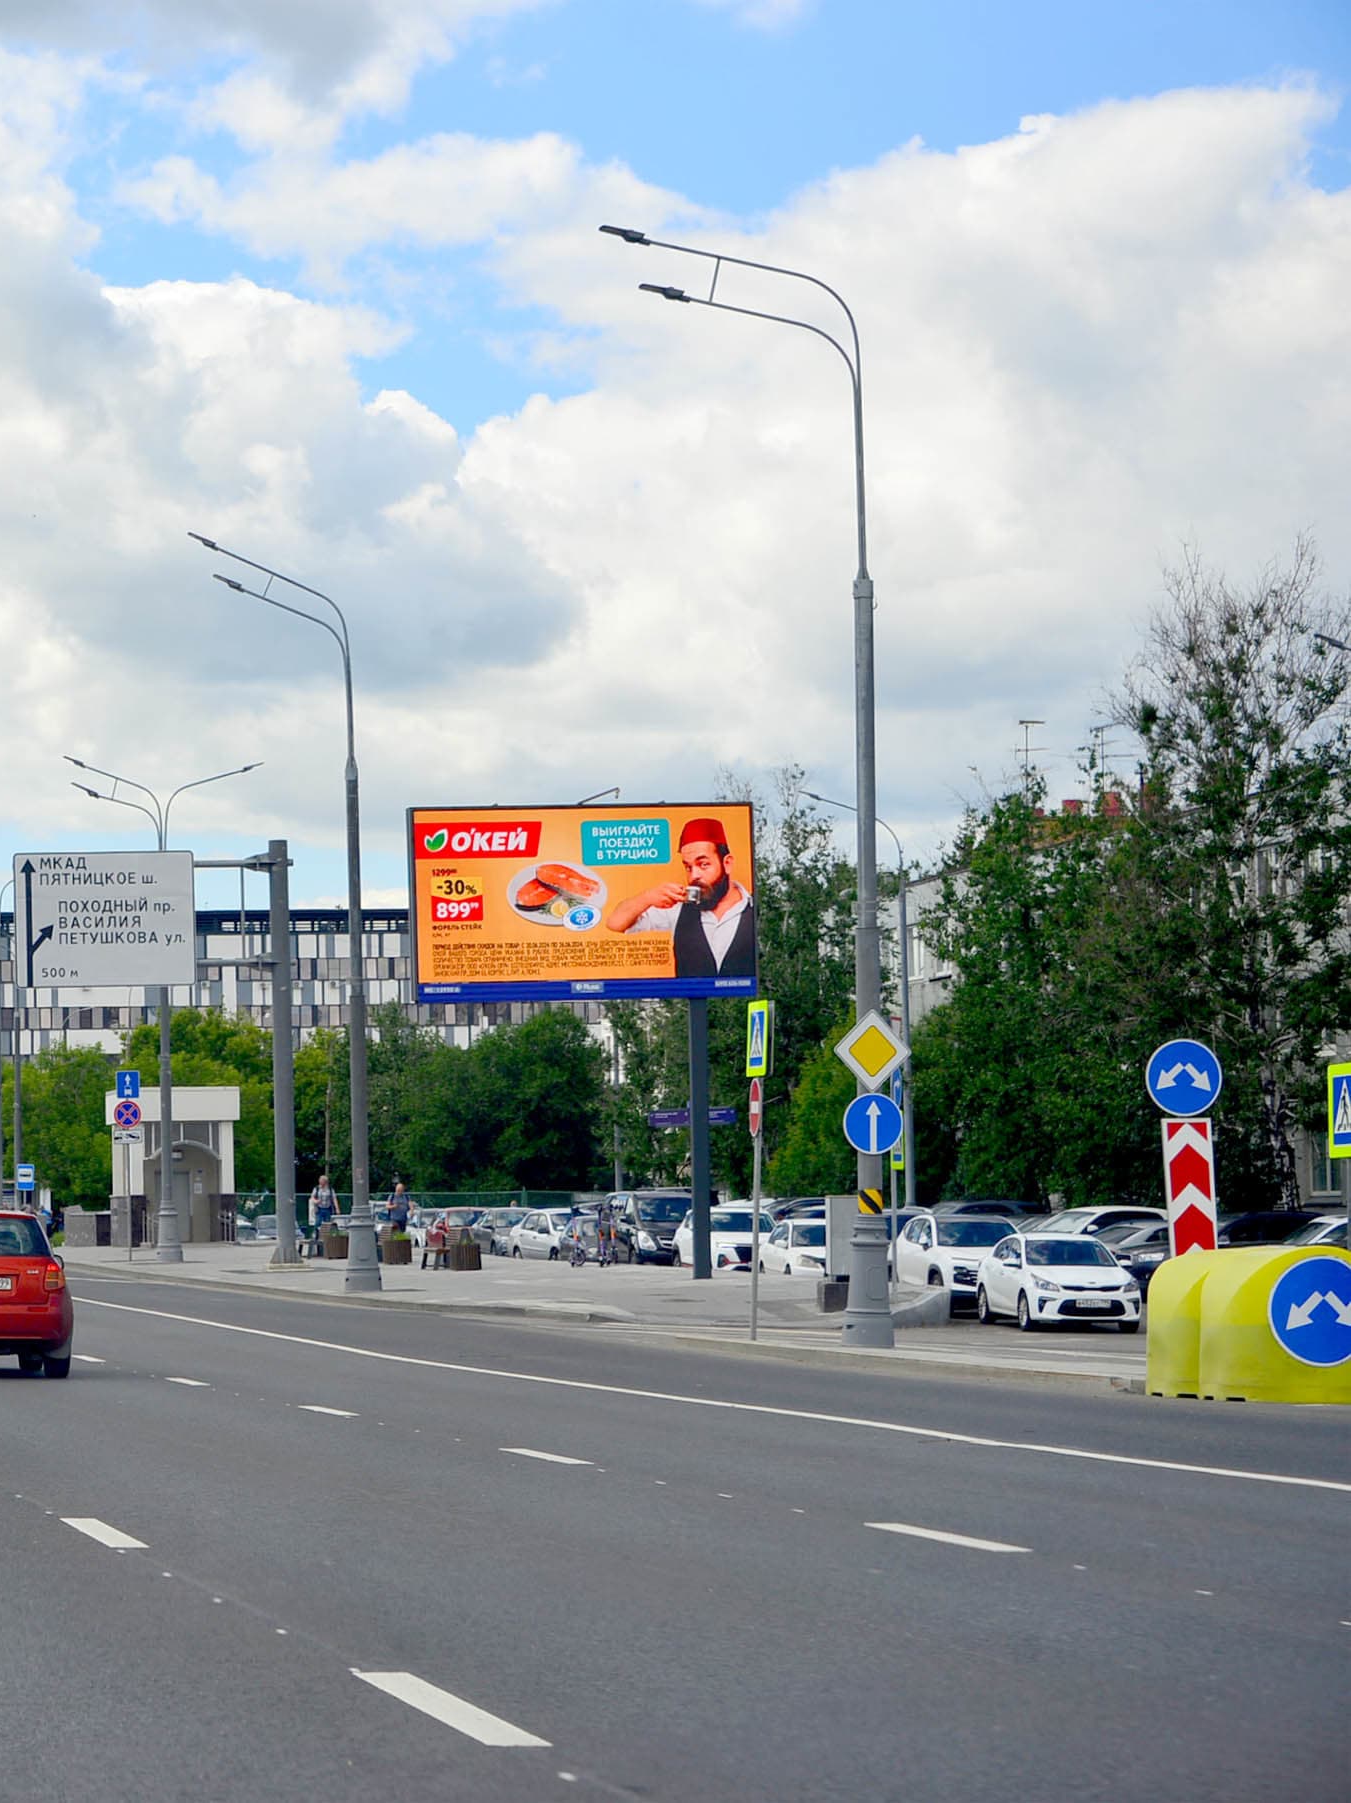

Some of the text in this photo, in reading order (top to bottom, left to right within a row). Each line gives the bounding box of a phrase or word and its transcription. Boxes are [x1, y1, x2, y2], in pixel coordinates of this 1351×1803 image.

[592, 824, 660, 837] ВЫИГРАЙТЕ
[599, 837, 654, 849] ПОЕЗДКУ
[596, 848, 659, 860] В ТУРЦИЮ
[39, 856, 88, 870] МКАД
[39, 872, 158, 887] ПЯТНИЦКОЕ ш.
[436, 880, 477, 895] -30%
[58, 897, 176, 915] ПОХОДНЫЙ пр.
[58, 915, 142, 930] ВАСИЛИЯ
[58, 931, 187, 947] ПЕТУШКОВА ул.
[41, 967, 79, 978] 500 м
